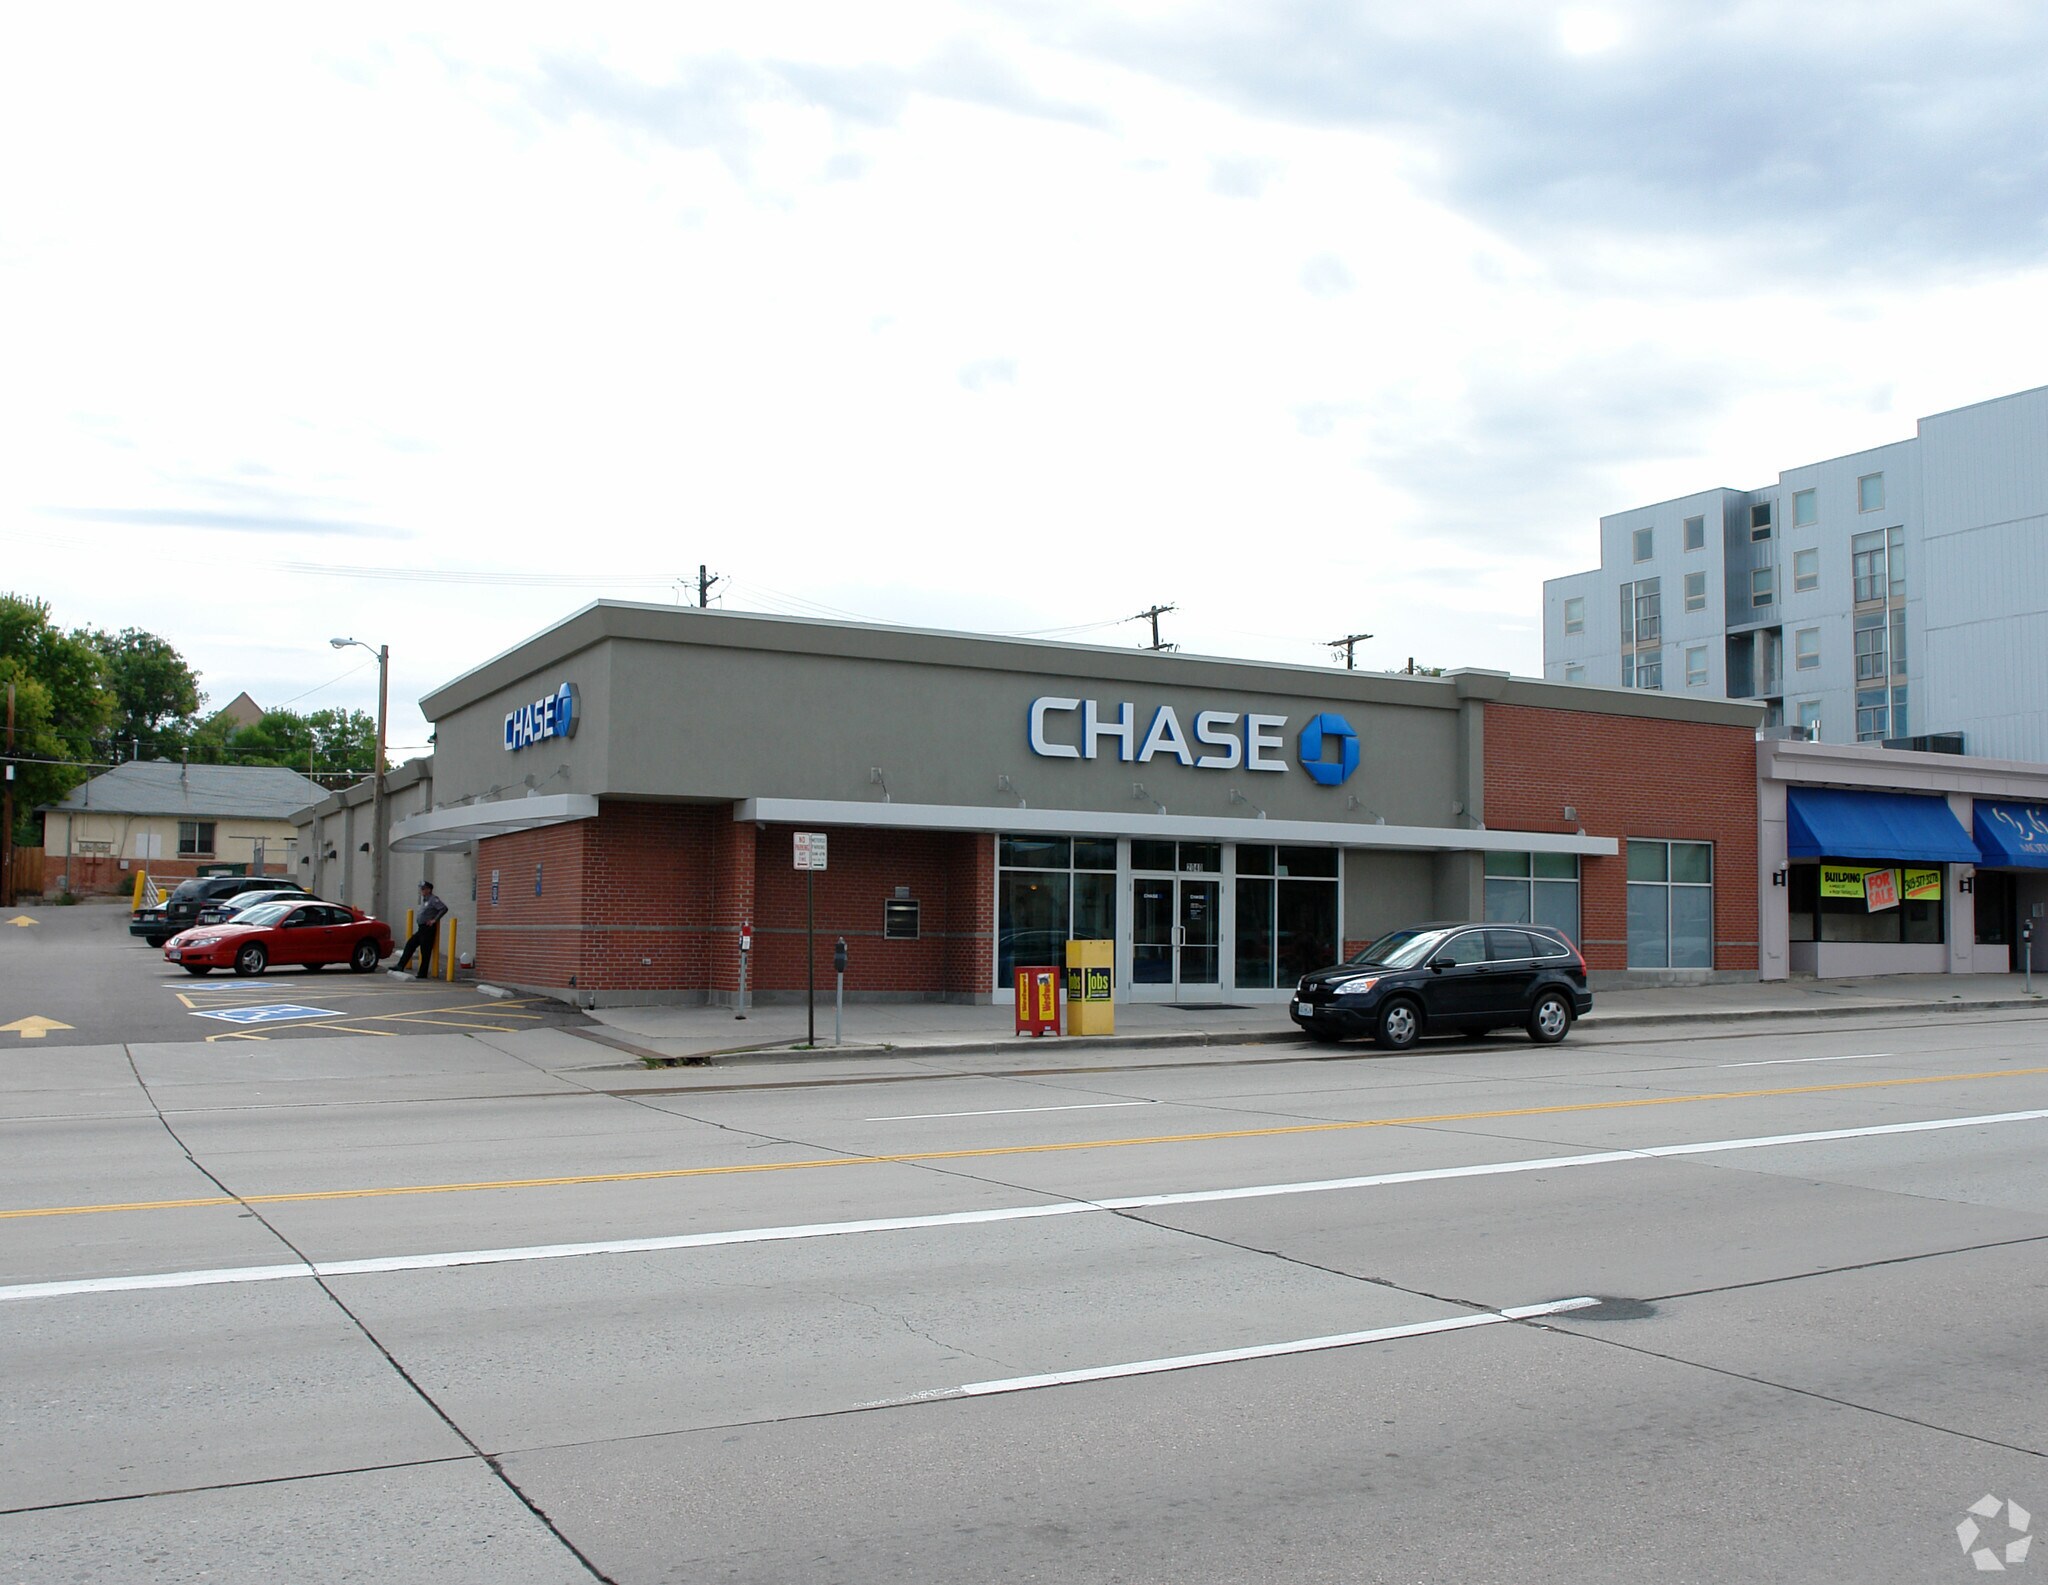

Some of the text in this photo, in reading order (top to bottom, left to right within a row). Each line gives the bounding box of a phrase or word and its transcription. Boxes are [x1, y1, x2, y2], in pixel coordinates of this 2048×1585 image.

[504, 694, 556, 751] CHASE
[1029, 696, 1289, 772] CHASE
[1824, 872, 1861, 883] BUILDING
[1868, 872, 1891, 890] FOR
[1869, 887, 1895, 909] SALE
[1087, 968, 1108, 999] jobs
